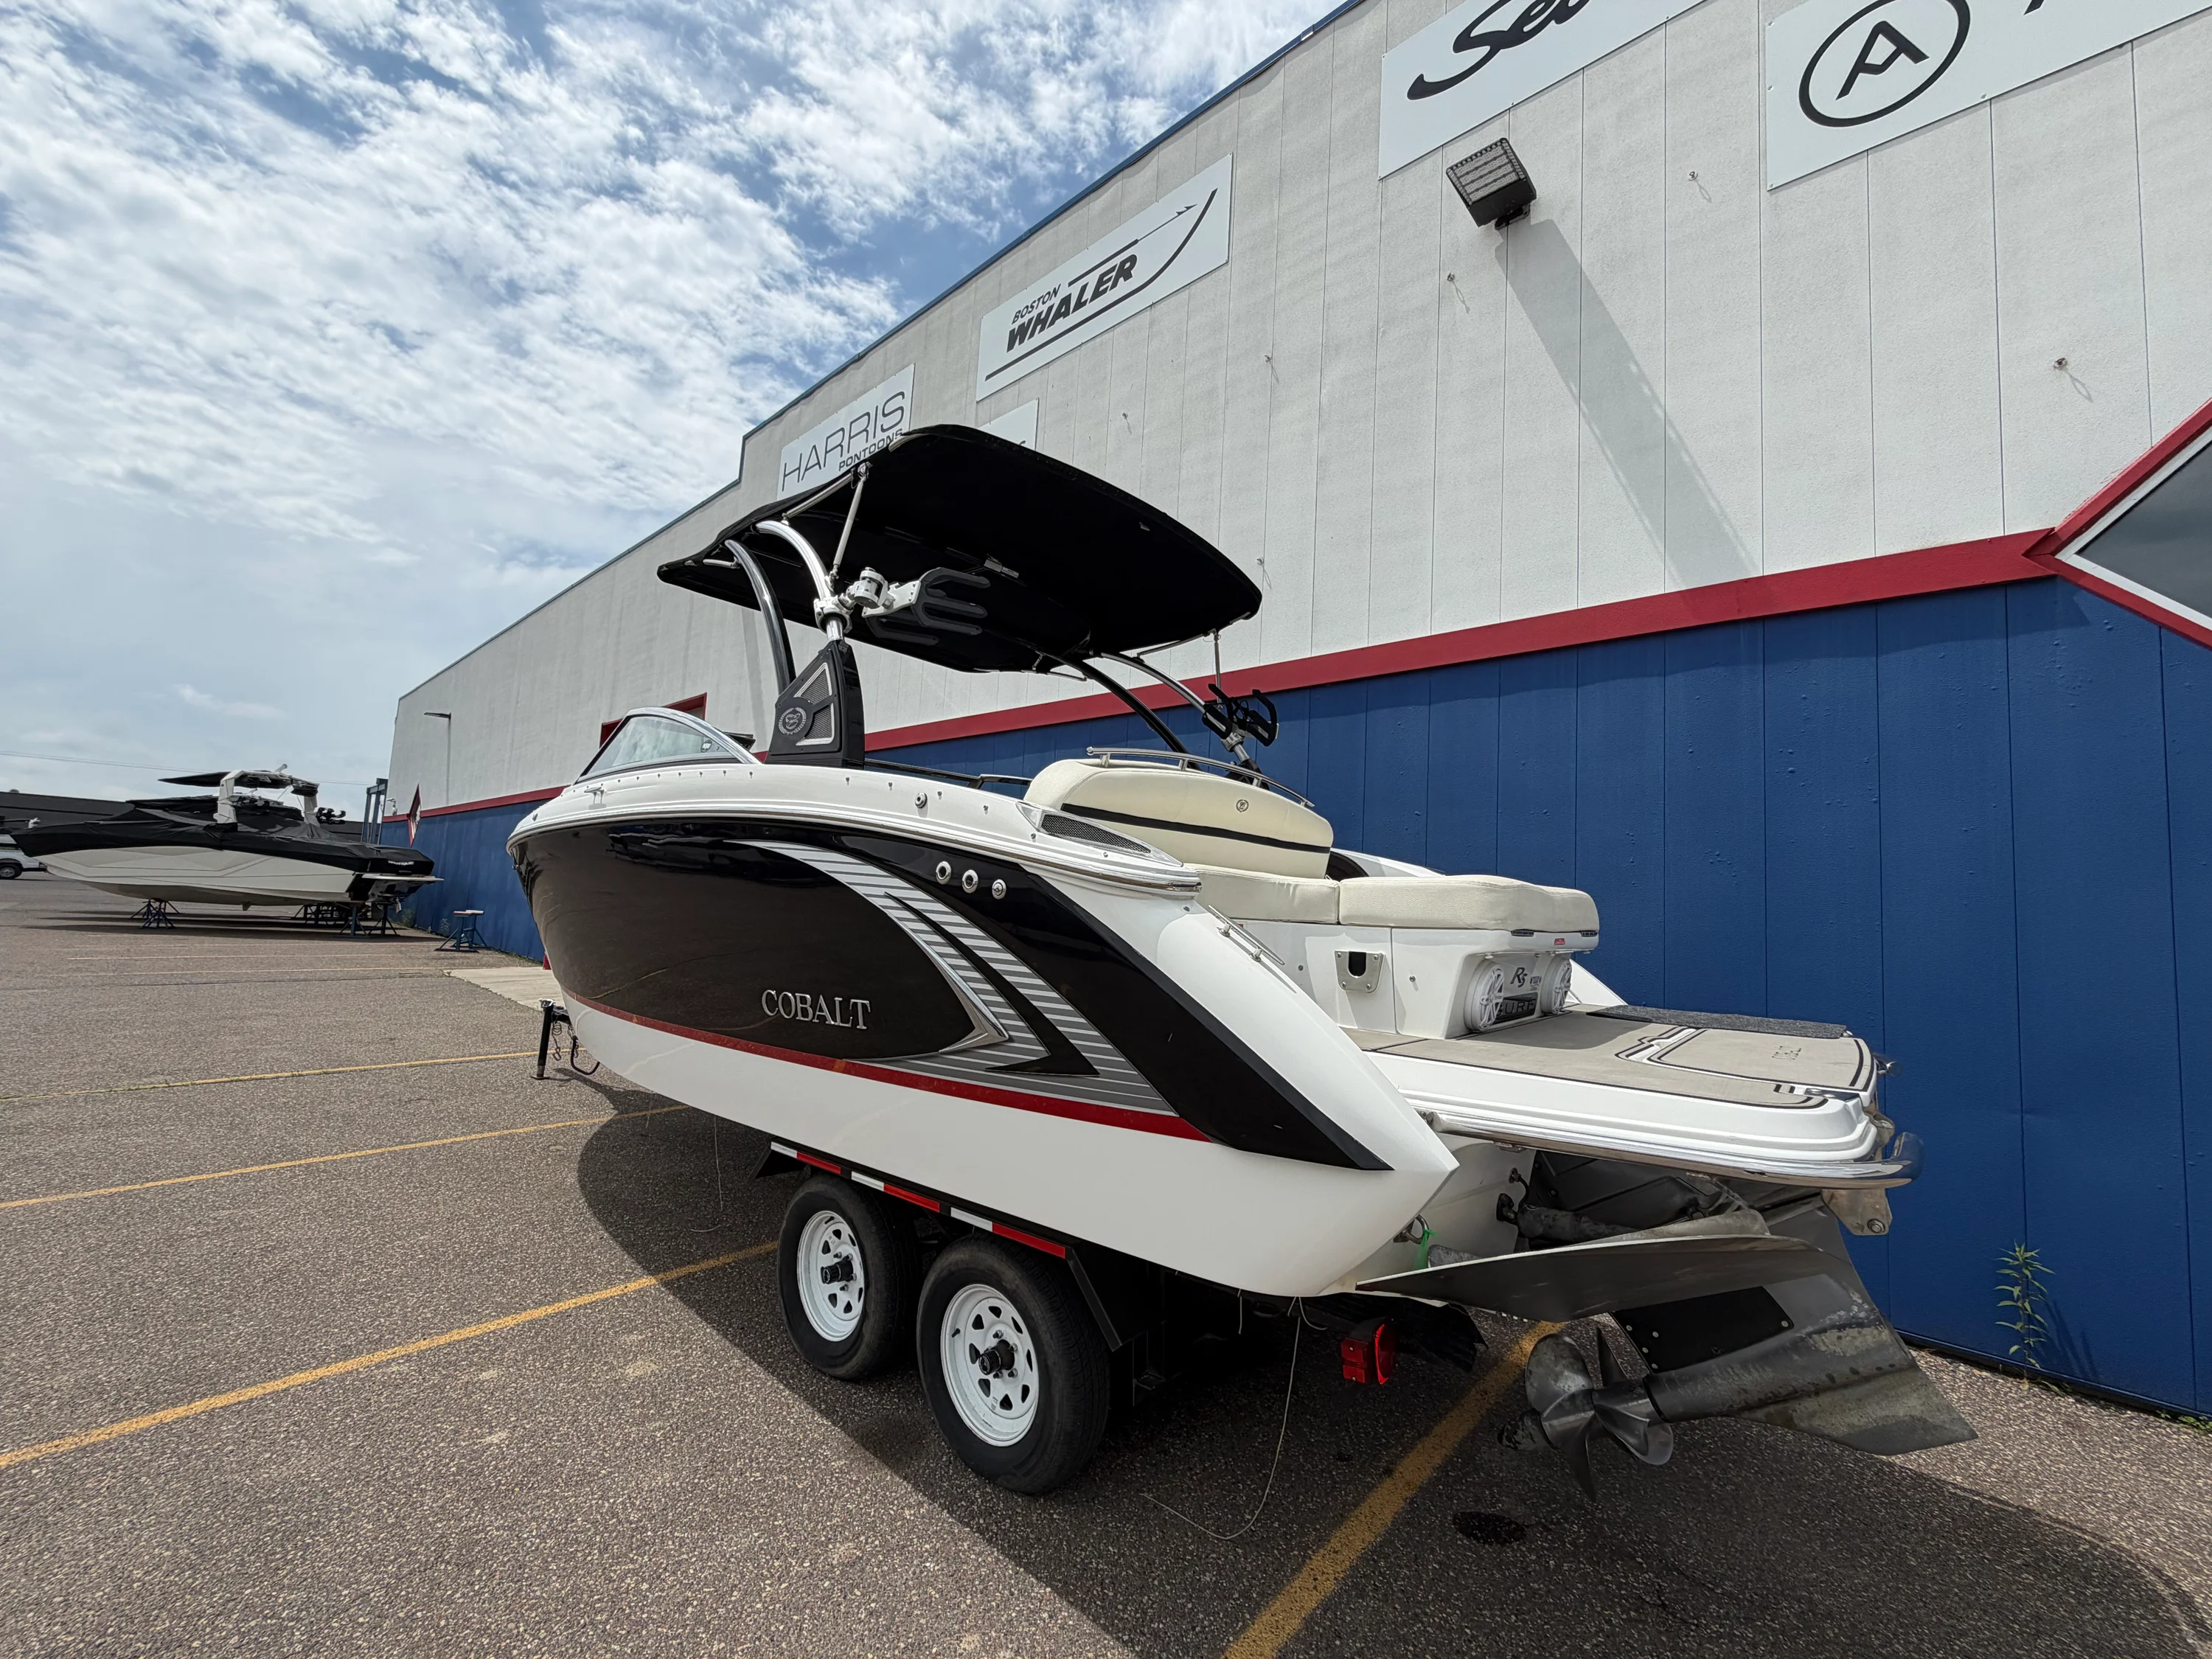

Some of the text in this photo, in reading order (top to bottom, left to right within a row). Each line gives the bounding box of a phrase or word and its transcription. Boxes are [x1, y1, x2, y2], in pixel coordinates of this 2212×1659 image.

[1834, 20, 1930, 101] A
[1006, 254, 1138, 353] WHALER
[1011, 283, 1062, 325] BOSTON
[782, 391, 905, 492] HARRIS
[838, 428, 903, 472] PONTOONS
[761, 989, 872, 1030] COBALT
